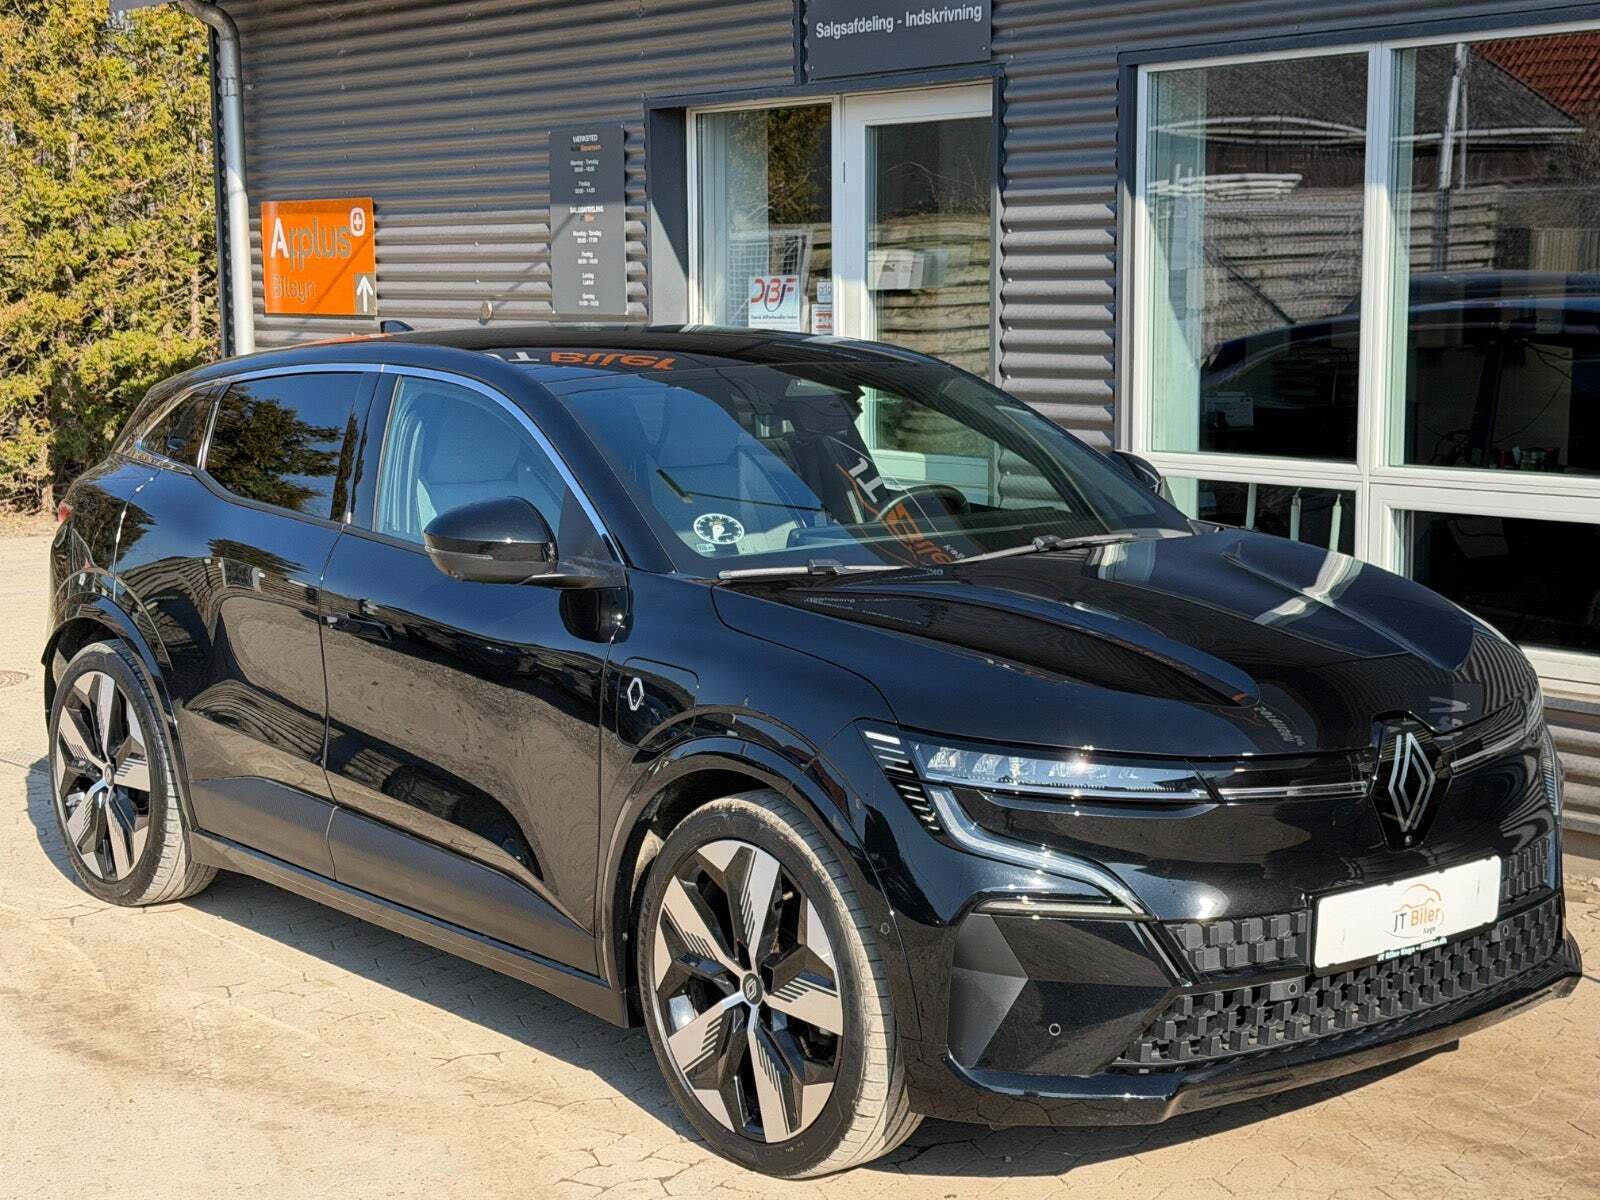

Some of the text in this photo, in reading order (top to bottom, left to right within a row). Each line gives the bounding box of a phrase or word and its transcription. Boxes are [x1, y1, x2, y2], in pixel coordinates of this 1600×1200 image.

[816, 15, 894, 39] Salgsafdeling
[905, 4, 983, 27] Indskrivning
[1393, 907, 1441, 933] JT Biler
